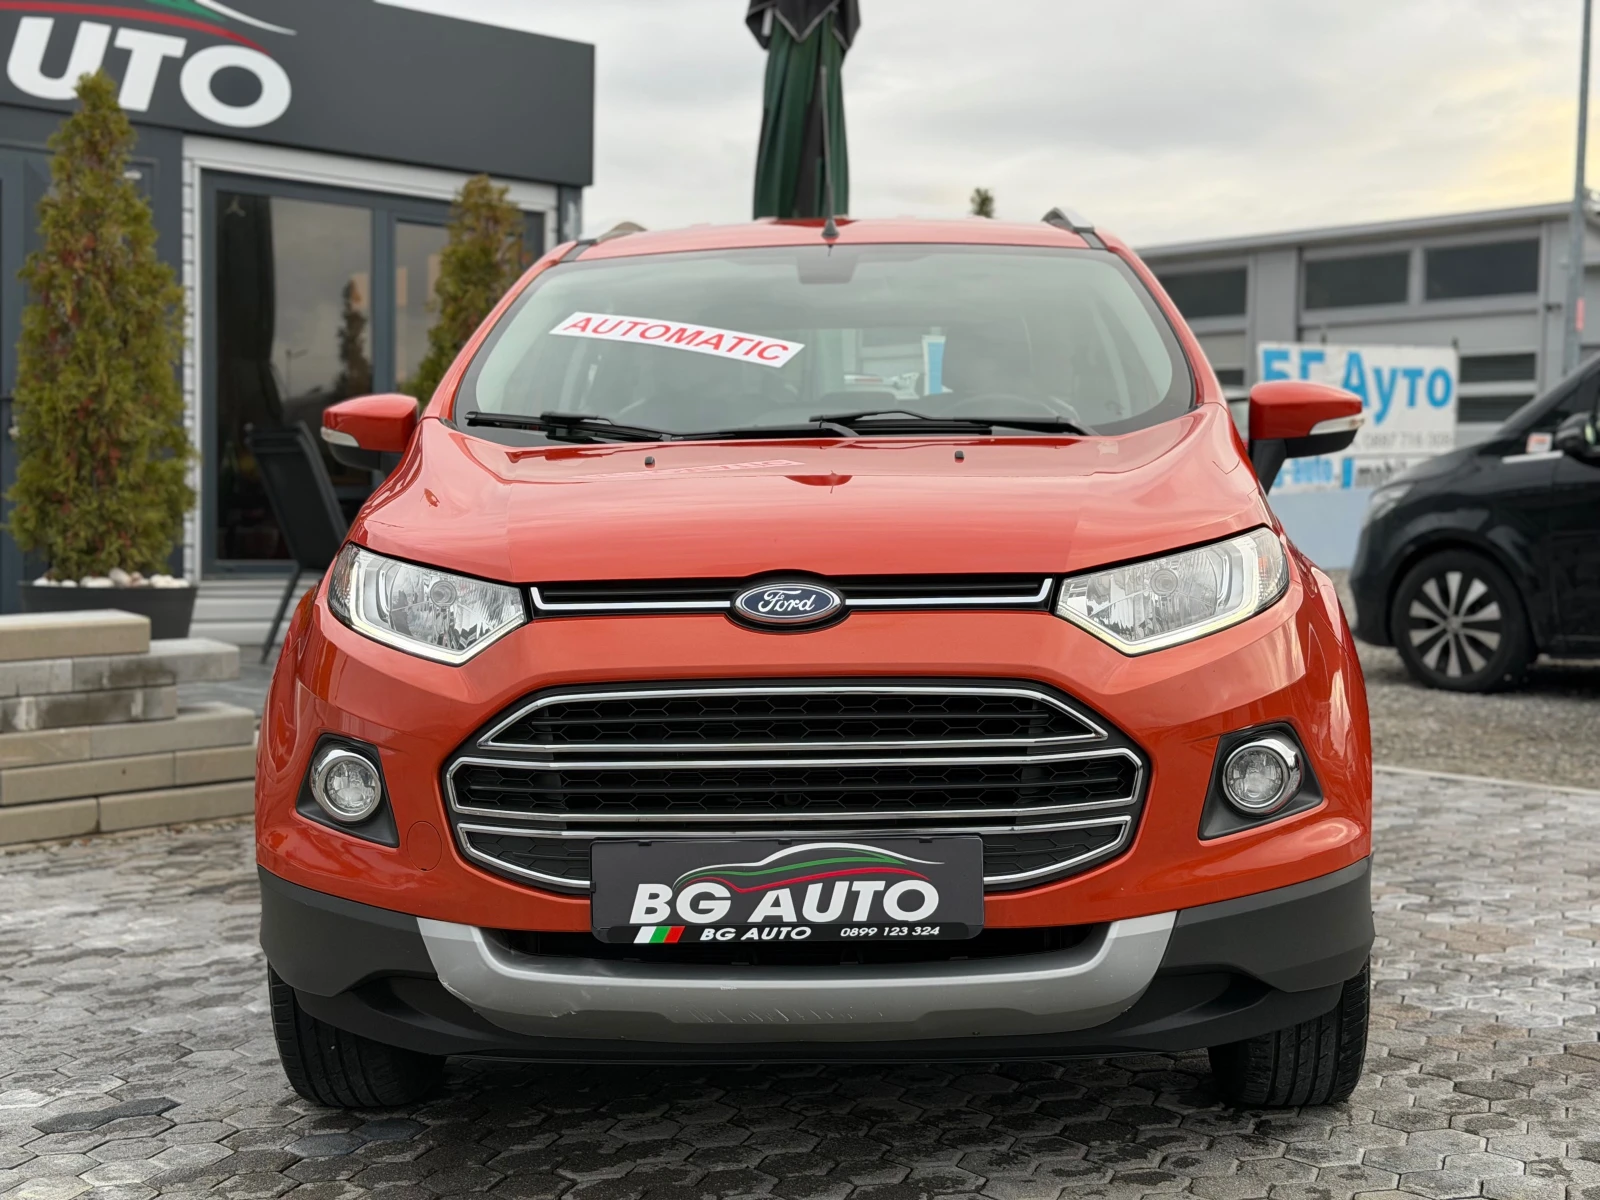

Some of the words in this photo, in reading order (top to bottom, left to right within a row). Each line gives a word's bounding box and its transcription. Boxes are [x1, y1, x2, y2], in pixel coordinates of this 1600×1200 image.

[563, 317, 789, 361] AUTOMATIC
[758, 590, 816, 617] Ford
[629, 882, 732, 924] BG
[747, 880, 939, 923] AUTO
[699, 927, 736, 941] BG
[740, 926, 812, 940] AUTO
[840, 926, 878, 937] 0899
[883, 926, 908, 937] 123
[911, 926, 940, 936] 324
